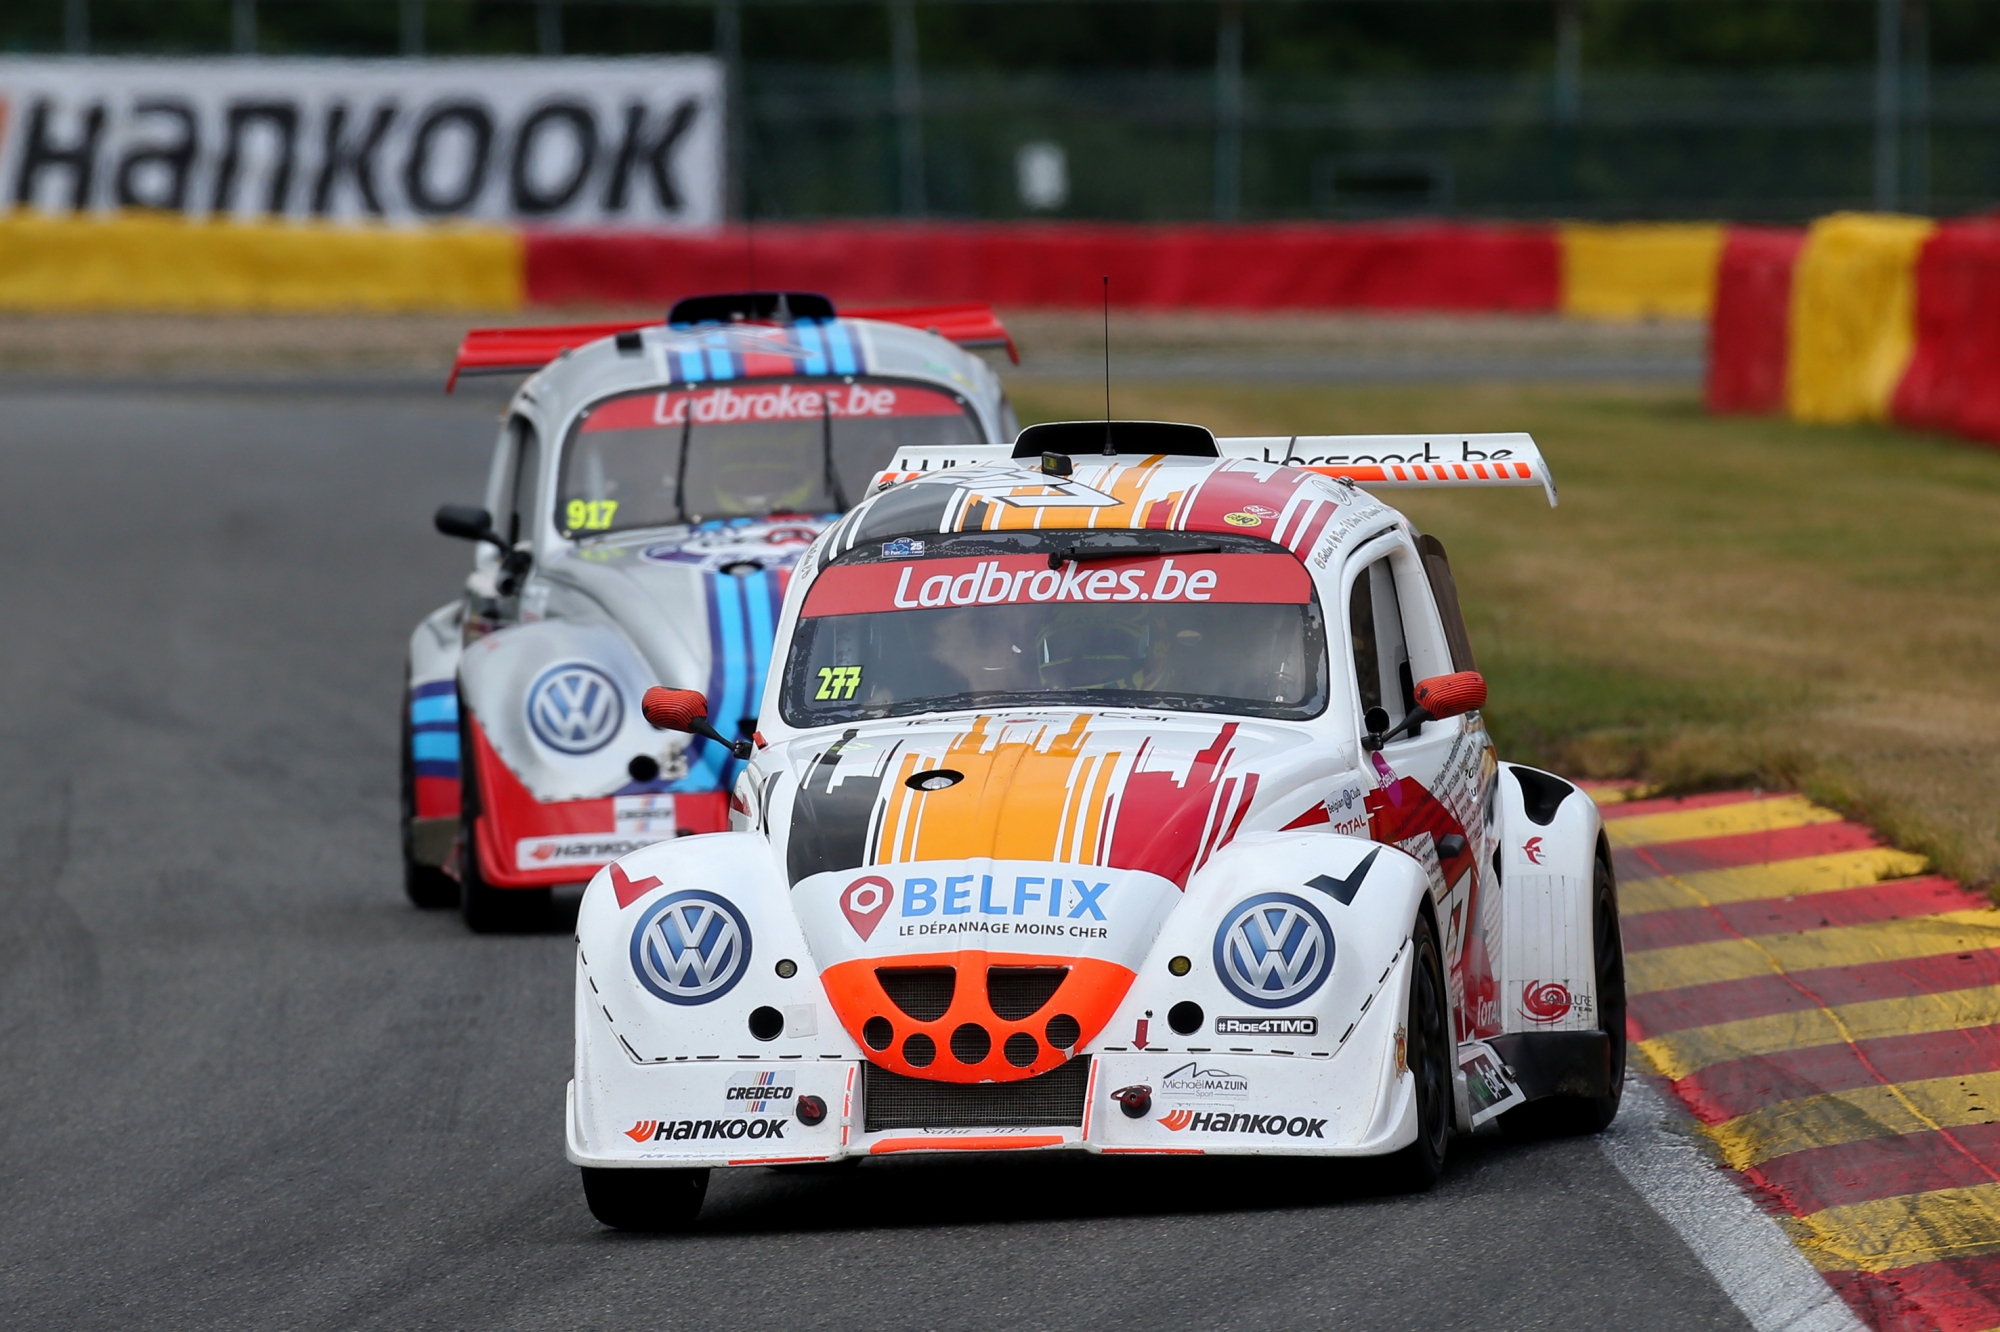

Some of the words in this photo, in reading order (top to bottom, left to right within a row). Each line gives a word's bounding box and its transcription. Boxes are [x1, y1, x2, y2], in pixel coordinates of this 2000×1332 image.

[653, 384, 896, 425] Ladbrokes.be
[566, 500, 617, 530] 917
[893, 559, 1217, 609] Ladbrokes.be
[814, 665, 862, 701] 277
[1334, 814, 1367, 835] TOTAL
[901, 875, 1110, 921] BELFIX
[900, 925, 915, 936] LE
[919, 921, 1010, 935] DÉPANNAGE
[1015, 924, 1065, 937] MOINS
[1069, 926, 1108, 939] CHER
[726, 1087, 793, 1100] CREDECO
